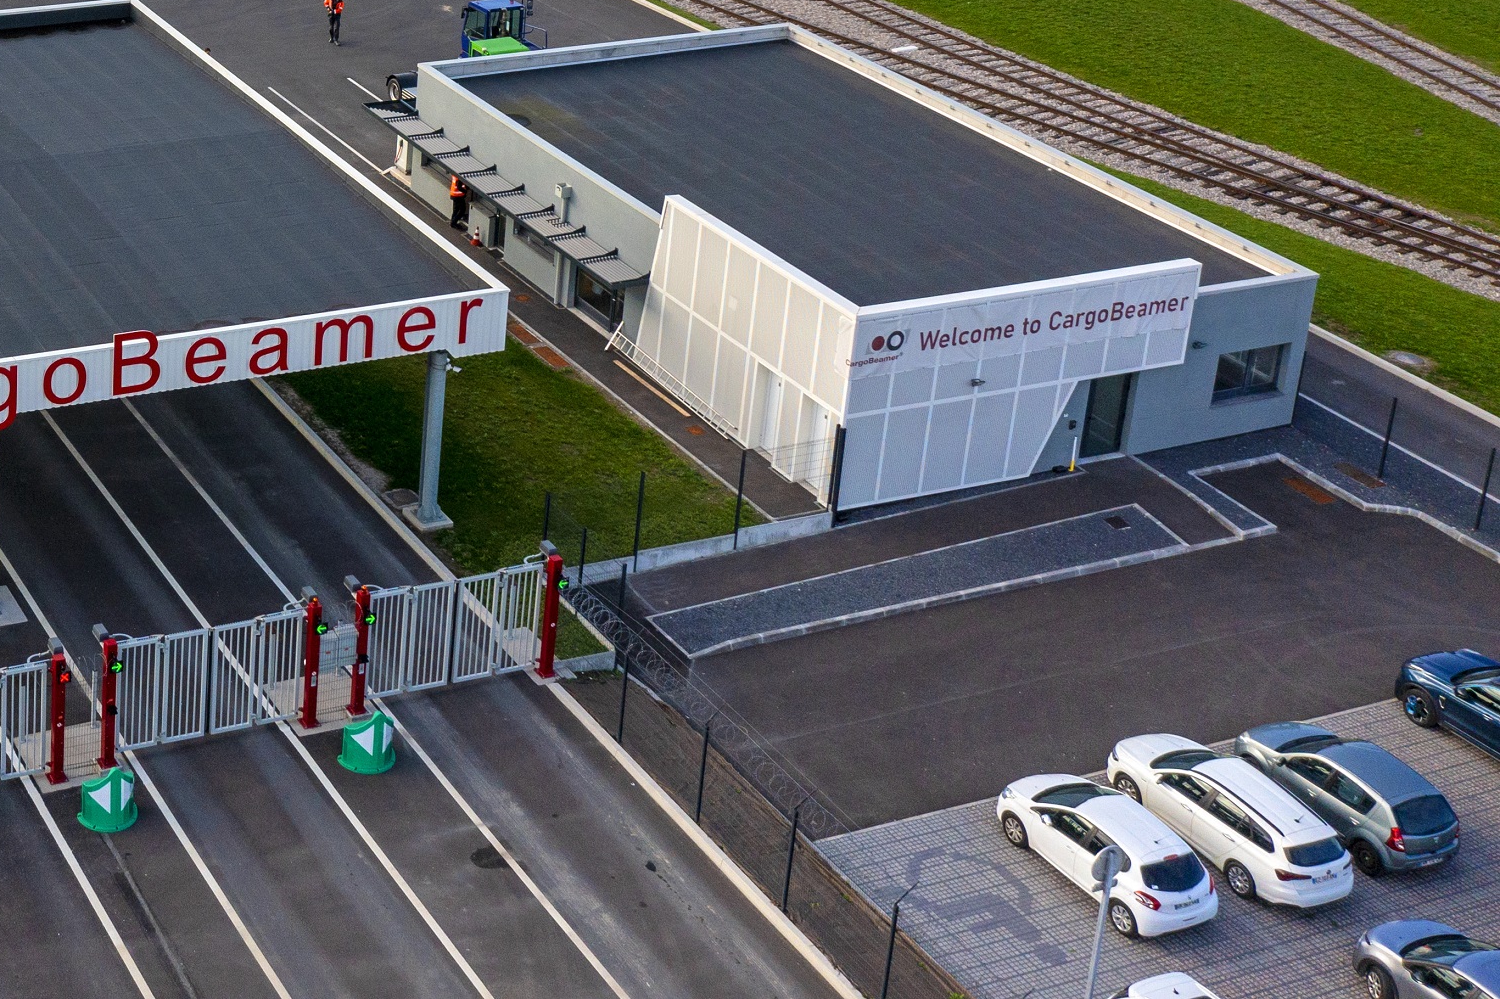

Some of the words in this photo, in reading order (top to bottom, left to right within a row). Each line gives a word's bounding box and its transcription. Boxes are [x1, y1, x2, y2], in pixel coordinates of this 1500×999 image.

[919, 324, 1014, 351] Welcome
[1023, 317, 1041, 335] to
[1049, 296, 1190, 331] CargoBeamer
